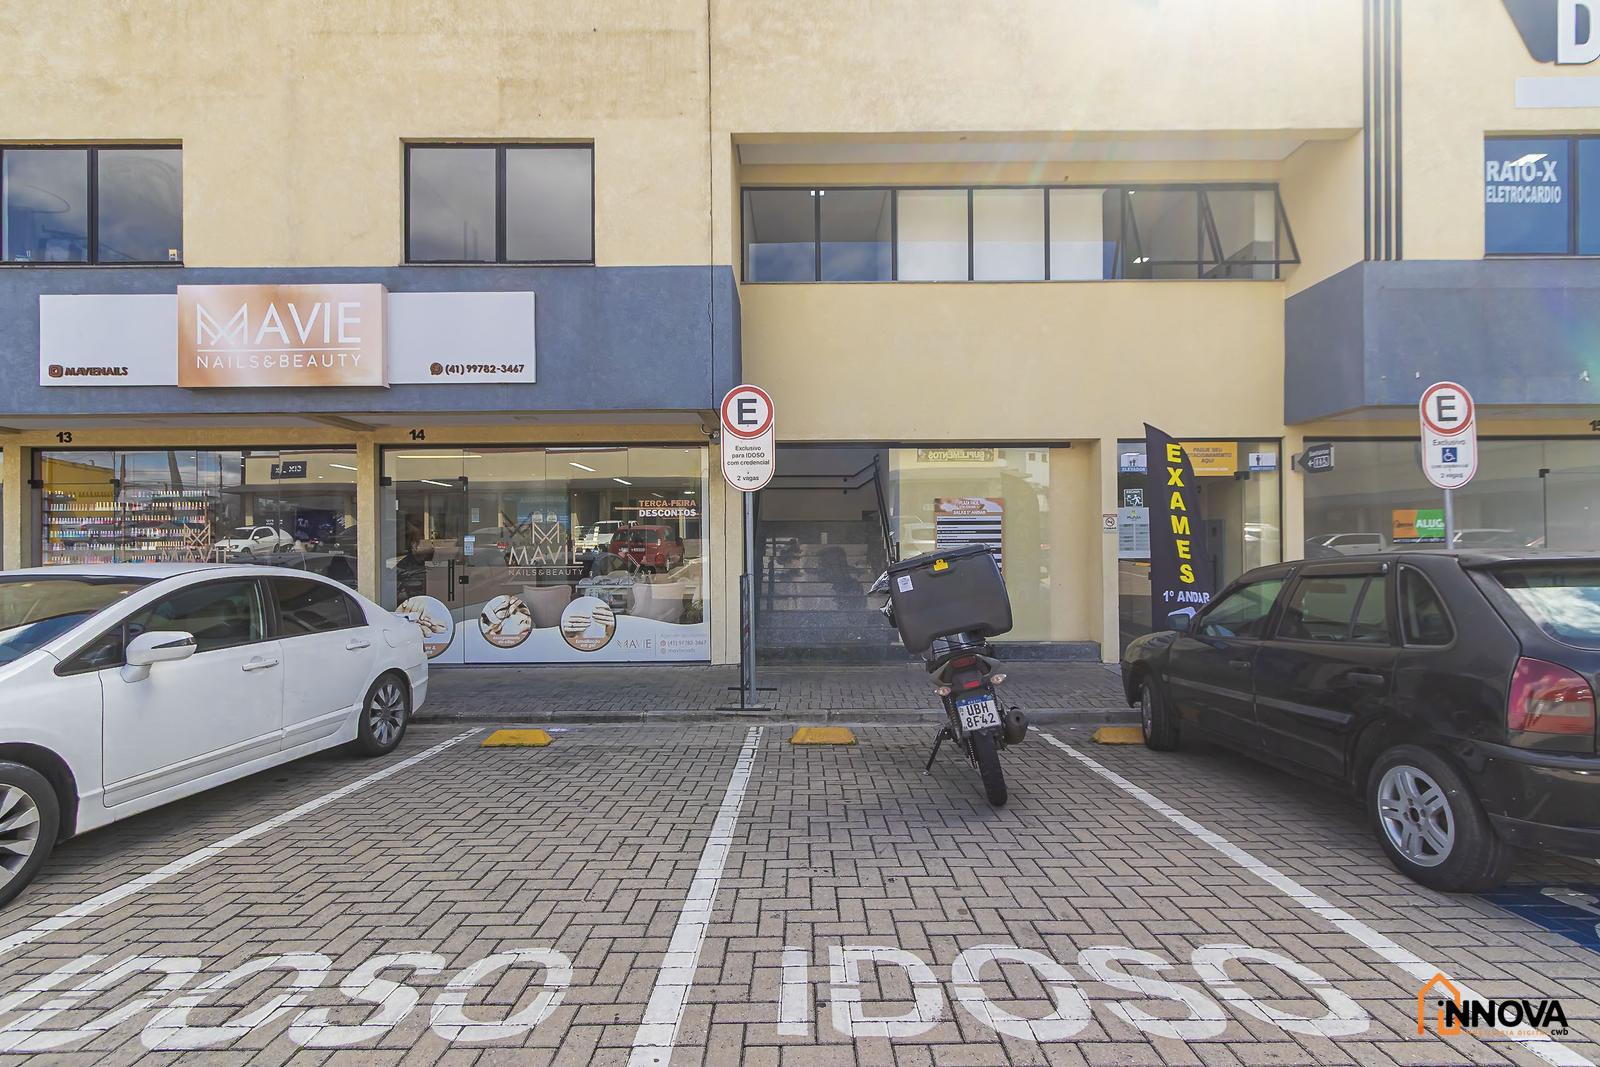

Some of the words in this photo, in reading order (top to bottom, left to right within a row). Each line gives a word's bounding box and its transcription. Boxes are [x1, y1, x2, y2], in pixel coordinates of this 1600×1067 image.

[1486, 160, 1557, 182] RAIO-X
[1486, 185, 1561, 203] ELETROCARDIO
[196, 301, 360, 345] MAVIE
[196, 354, 361, 369] NAILS&BEAUTY
[445, 364, 464, 375] (41)
[466, 364, 524, 374] 99782-3467
[737, 399, 758, 425] E
[1437, 396, 1457, 422] E
[56, 431, 72, 443] 13
[409, 429, 425, 440] 14
[640, 509, 697, 517] DESCONTOS
[1166, 443, 1195, 584] EXAMES
[508, 546, 583, 565] MAVIE
[1163, 590, 1174, 602] 1º
[1177, 591, 1210, 604] ANDAR
[966, 702, 988, 716] UBH
[776, 943, 1371, 1041] IDOSO
